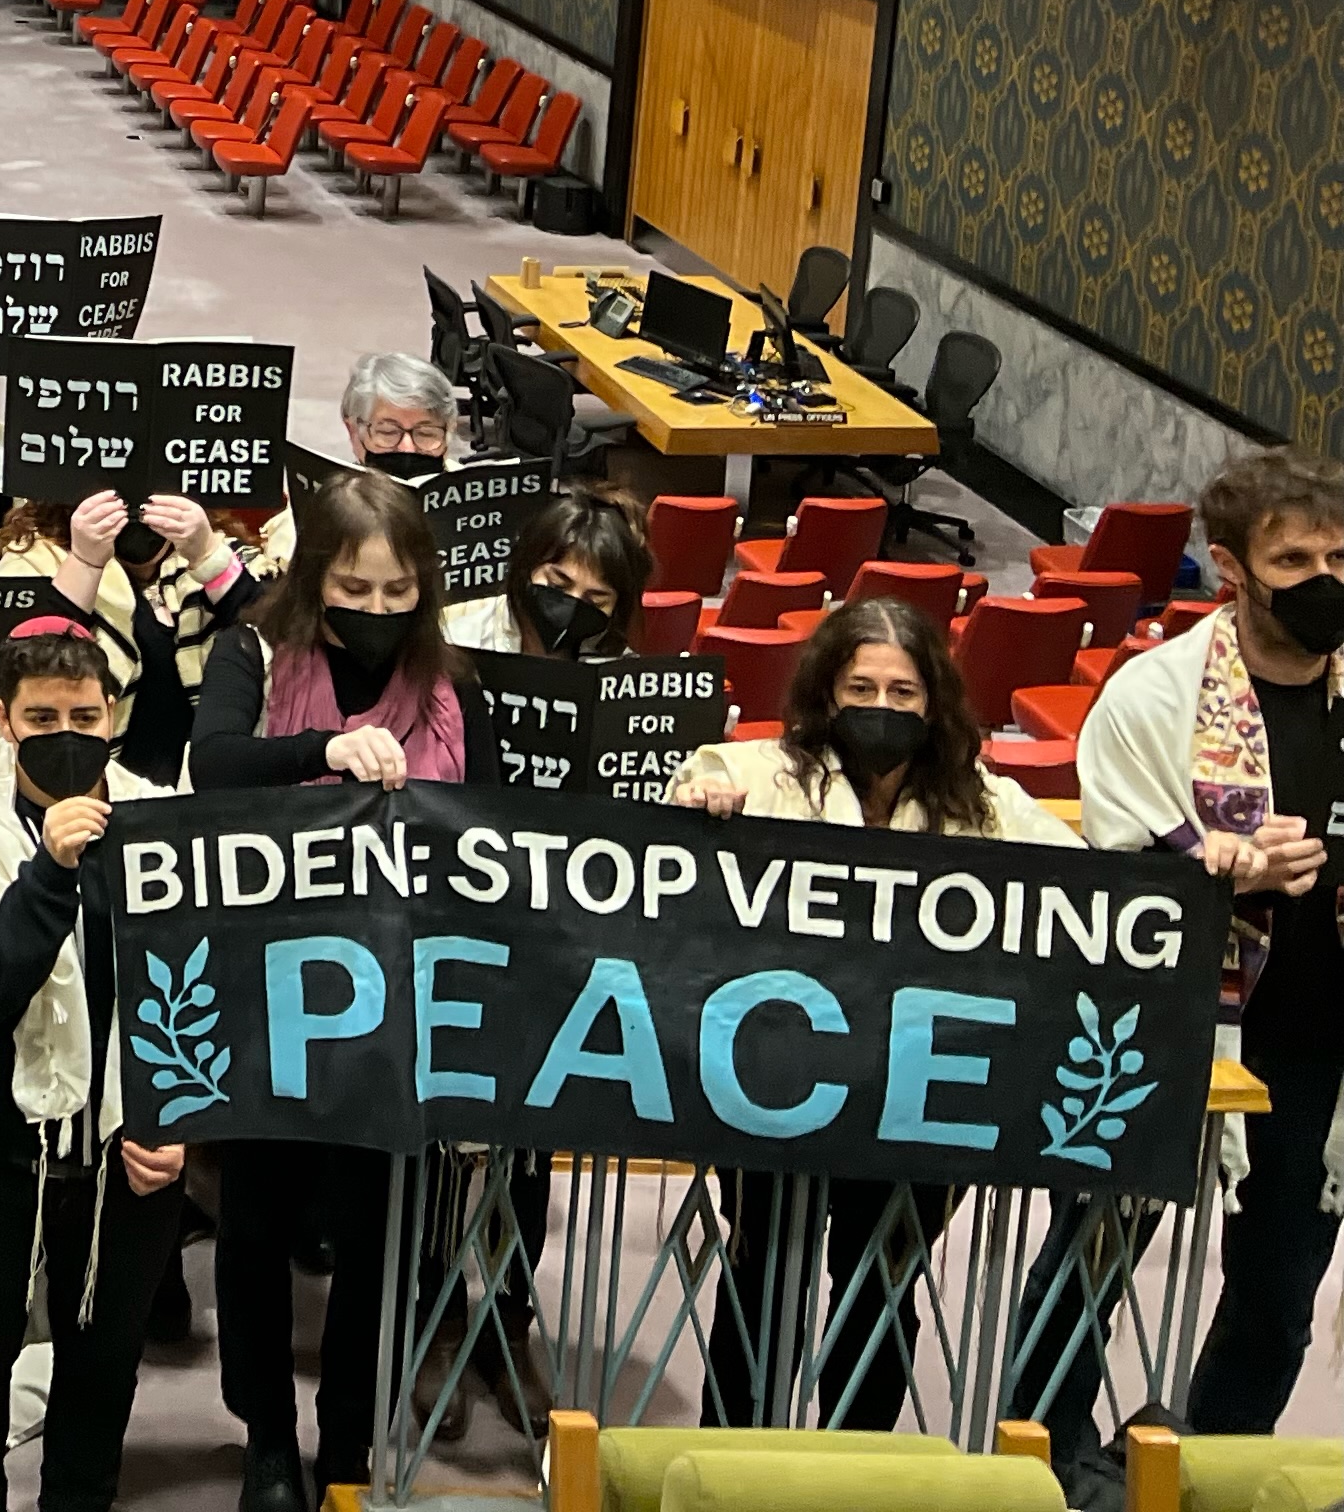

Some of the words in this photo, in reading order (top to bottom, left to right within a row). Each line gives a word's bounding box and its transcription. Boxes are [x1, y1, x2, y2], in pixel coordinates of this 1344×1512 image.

[79, 232, 154, 258] RABBIS
[100, 270, 130, 289] FOR
[78, 298, 139, 327] CEASE
[162, 363, 283, 389] RABBIS
[18, 376, 138, 412] רודפי
[195, 404, 242, 423] FOR
[20, 424, 134, 468] שלום
[164, 438, 271, 464] CEASE
[181, 468, 252, 494] FIRE
[423, 474, 541, 513] RABBIS
[456, 511, 502, 532] FOR
[437, 537, 511, 569] EAS
[599, 671, 714, 701] RABBIS
[483, 689, 577, 733] רוד
[628, 714, 675, 734] FOR
[500, 739, 571, 789] של
[598, 750, 696, 778] CEAS
[612, 781, 663, 803] FIR
[122, 821, 431, 914] BIDEN:
[447, 826, 697, 919] STOP
[716, 850, 1183, 969] VETOING
[264, 935, 1017, 1155] PEACE
